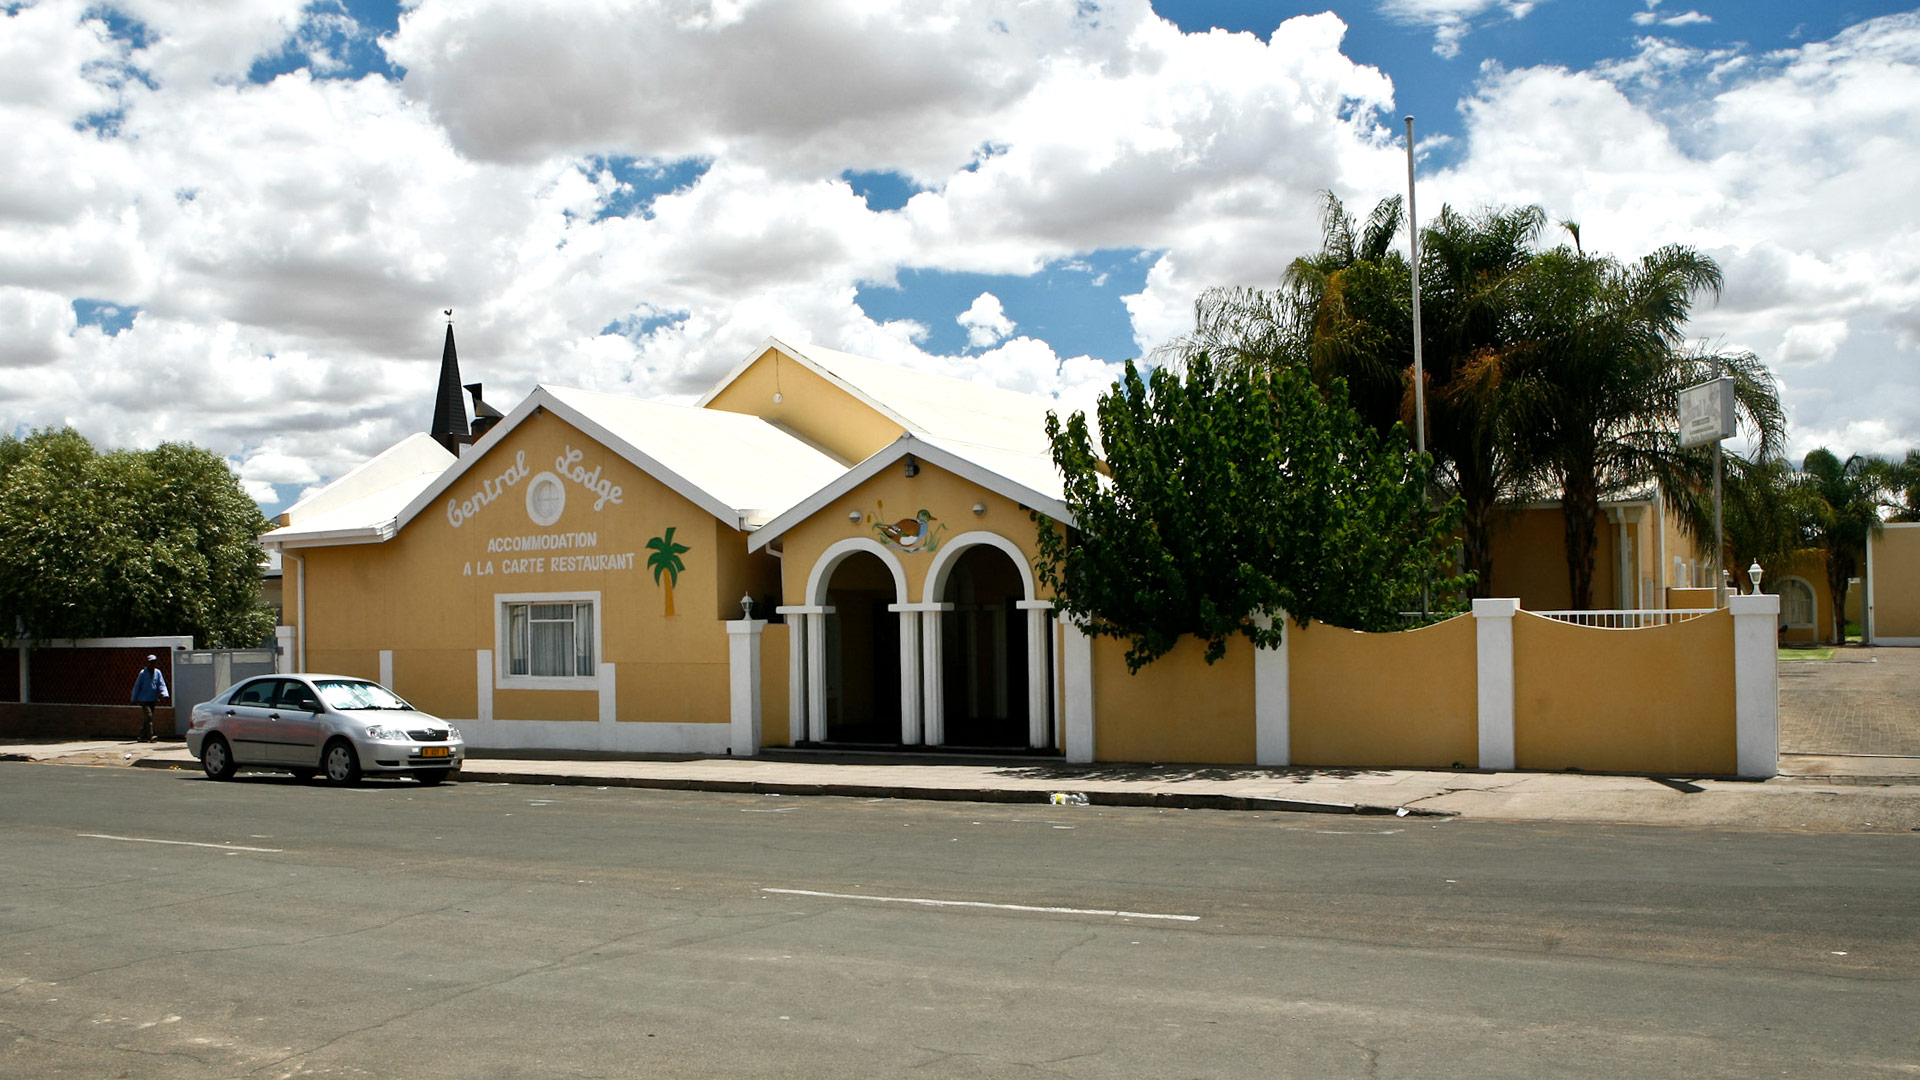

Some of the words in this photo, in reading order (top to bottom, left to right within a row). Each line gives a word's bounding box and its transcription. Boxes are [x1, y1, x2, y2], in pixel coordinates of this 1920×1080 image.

[447, 450, 530, 528] Central
[555, 445, 623, 511] Lodge
[488, 532, 597, 553] ACCOMMODATION
[463, 562, 472, 576] A
[477, 561, 494, 576] LA
[502, 557, 544, 575] CARTE
[551, 553, 635, 572] RESTAURANT
